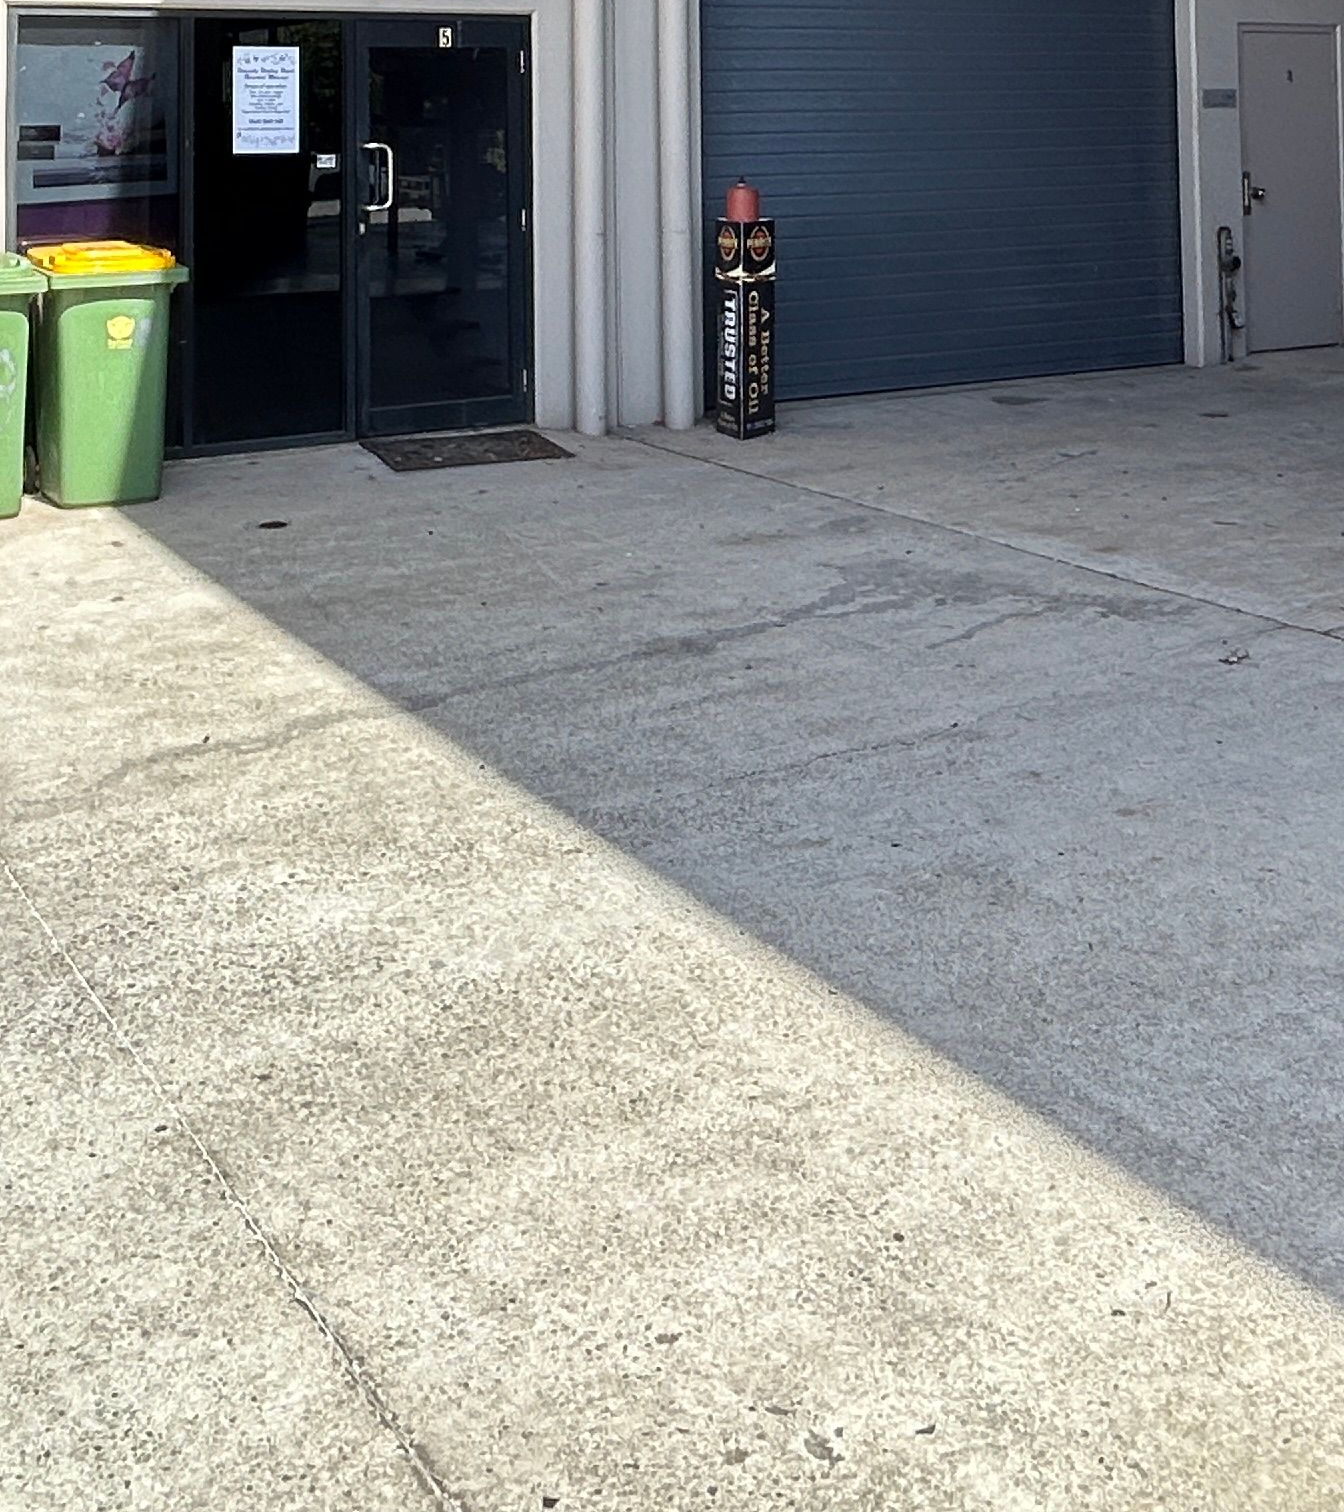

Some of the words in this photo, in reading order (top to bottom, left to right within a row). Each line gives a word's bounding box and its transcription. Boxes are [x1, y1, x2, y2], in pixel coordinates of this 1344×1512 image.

[441, 30, 450, 46] 5
[760, 308, 771, 324] A
[724, 299, 737, 401] TRUSTED
[748, 354, 759, 376] of
[748, 382, 760, 415] Oil
